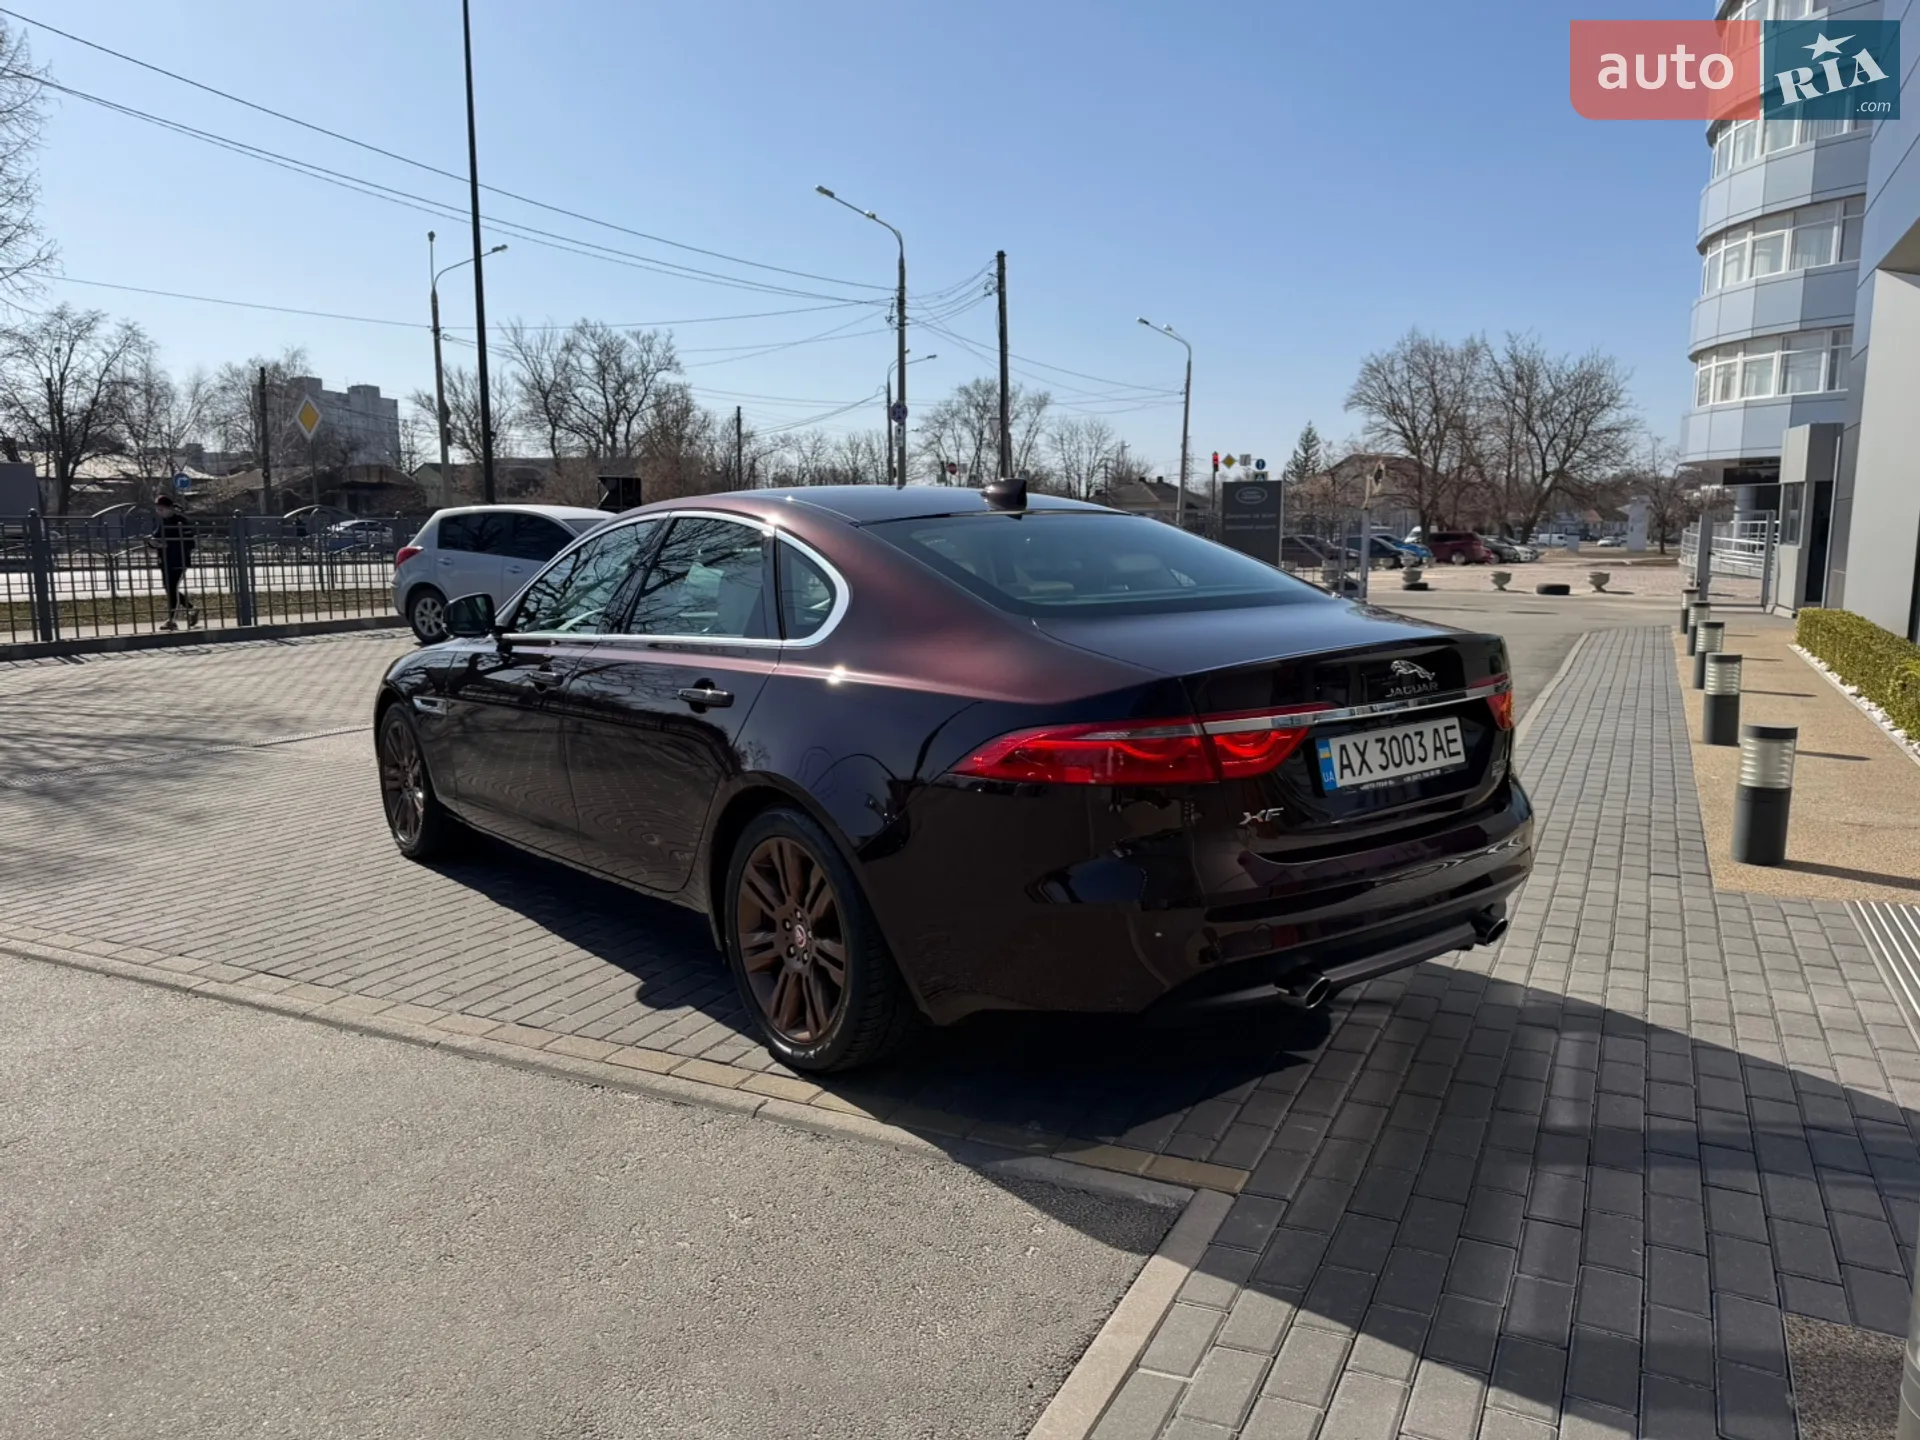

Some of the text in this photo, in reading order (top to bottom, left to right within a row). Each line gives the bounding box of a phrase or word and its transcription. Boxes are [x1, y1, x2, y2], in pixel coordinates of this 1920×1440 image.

[1384, 681, 1439, 697] JAGUAR
[1339, 724, 1461, 780] AX 3003 AE
[1322, 770, 1336, 783] UA
[1239, 807, 1284, 826] XF
